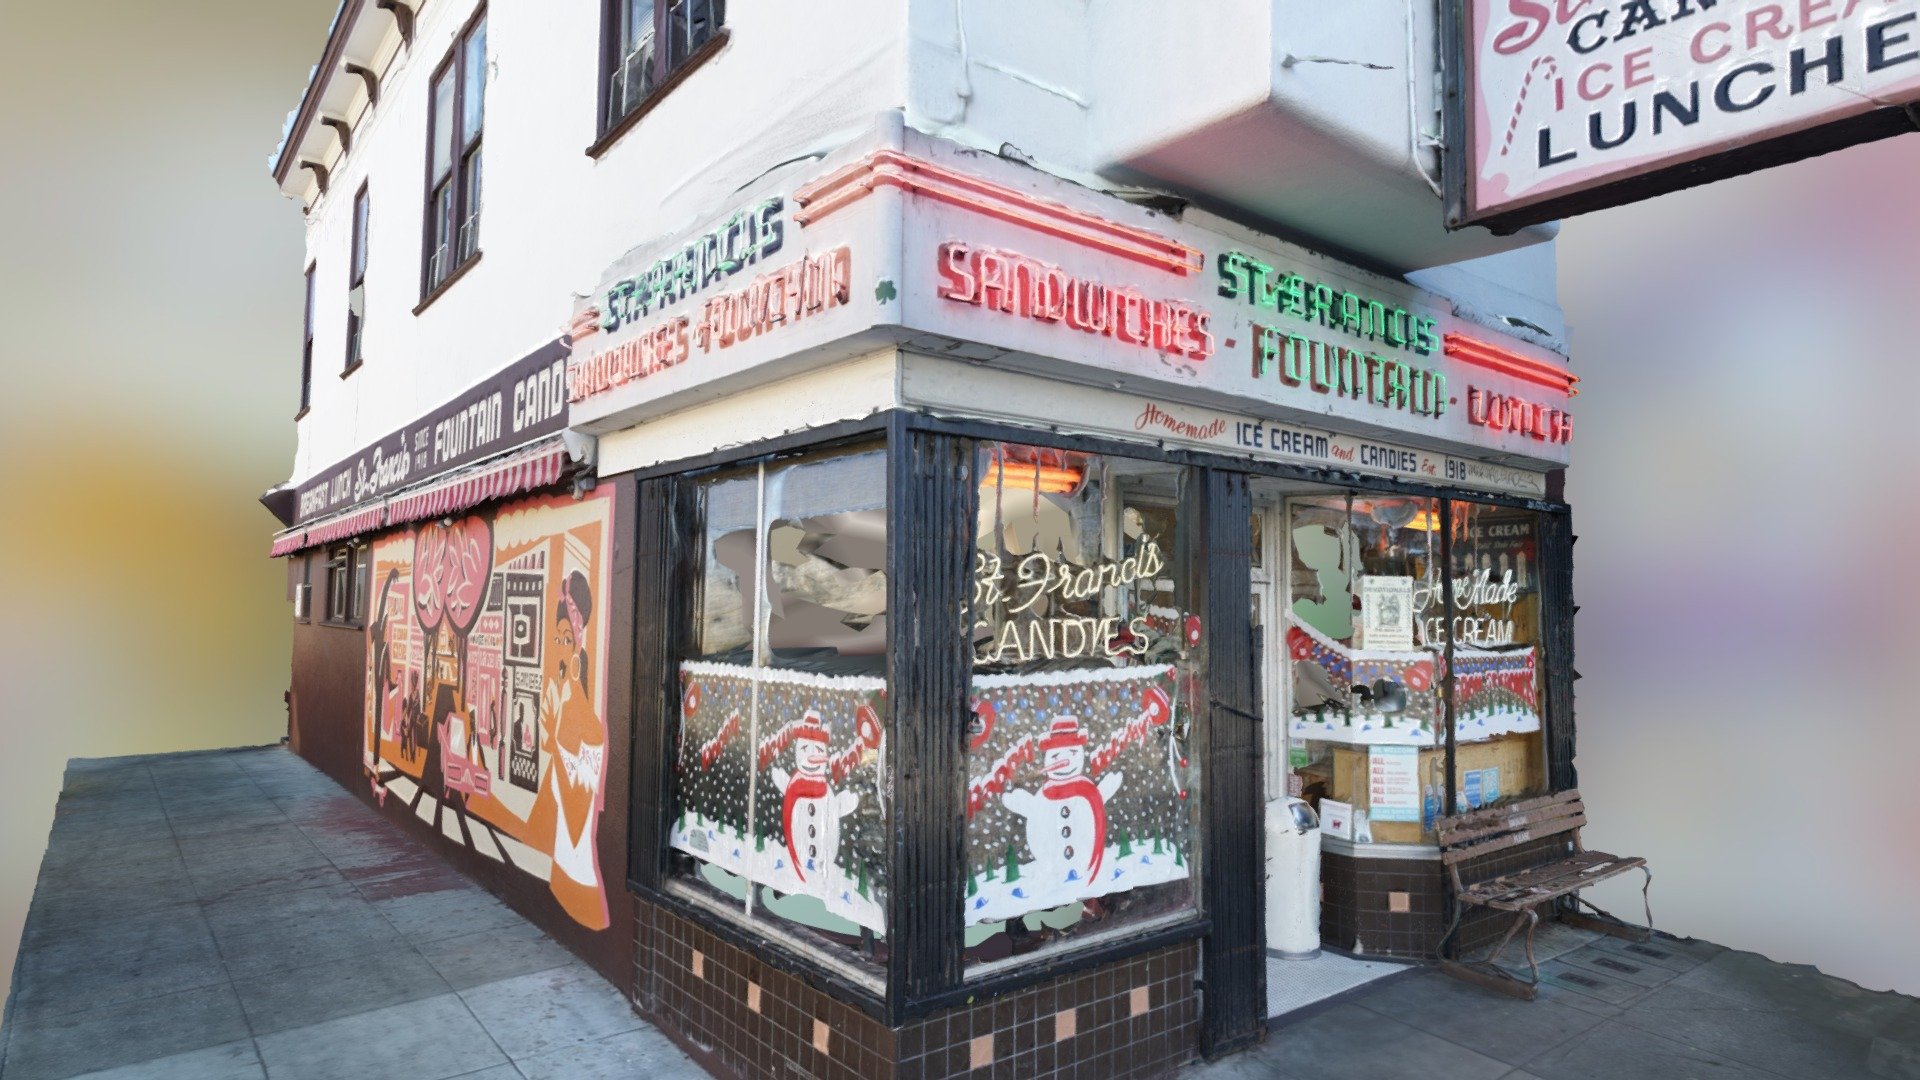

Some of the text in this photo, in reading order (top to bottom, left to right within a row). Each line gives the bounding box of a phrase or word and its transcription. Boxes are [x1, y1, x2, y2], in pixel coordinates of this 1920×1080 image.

[1554, 47, 1653, 111] ICE
[937, 239, 1573, 445] SANDWICHES FOUNTAIN LUNCH
[434, 358, 569, 465] FOUNTAIN CAND
[1135, 402, 1226, 440] Homemade
[1236, 421, 1263, 448] ICE
[1271, 428, 1328, 458] CREAM
[1331, 444, 1355, 463] and
[1360, 443, 1417, 472] CANDIES
[1444, 458, 1467, 480] 1918
[1488, 523, 1530, 538] CREAM
[1009, 533, 1164, 613] Francis
[1453, 616, 1514, 645] CREAM
